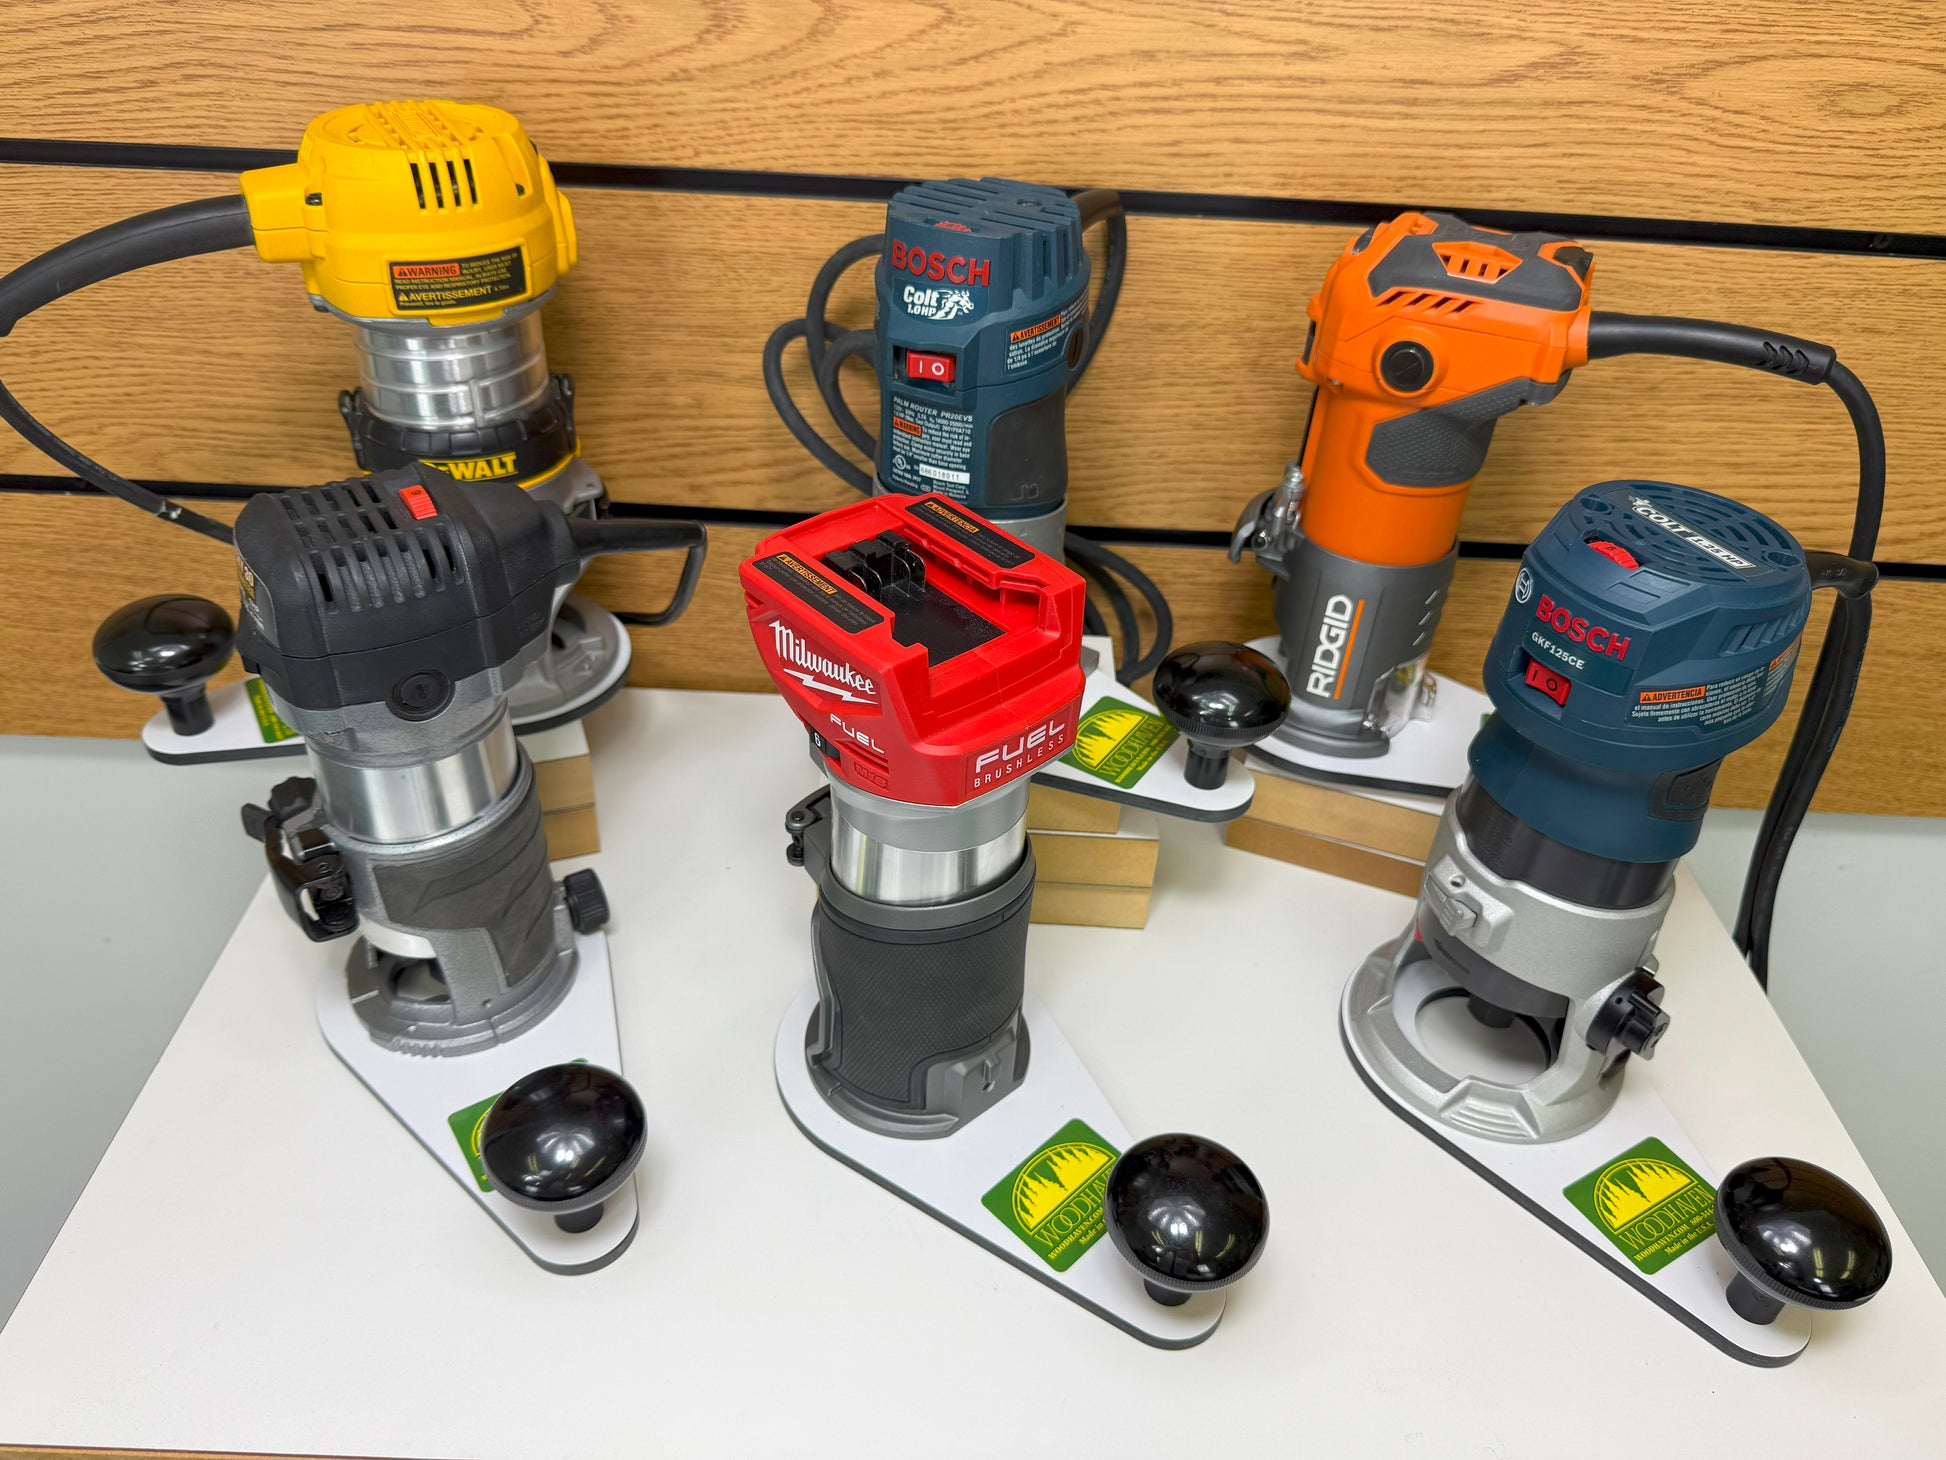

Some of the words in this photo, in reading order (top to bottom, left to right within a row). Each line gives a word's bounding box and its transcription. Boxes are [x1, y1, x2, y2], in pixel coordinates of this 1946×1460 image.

[407, 266, 456, 277] WARNING
[892, 239, 990, 286] BOSCH
[409, 286, 493, 301] AVERTISSEMENT
[903, 284, 939, 306] Colt
[1020, 316, 1060, 338] AVERTISSEMENT
[894, 396, 909, 408] PALM
[910, 403, 937, 416] ROUTER
[941, 411, 973, 422] PR20EVS
[437, 456, 516, 480] WALT
[934, 504, 978, 533] ADVERTENCIA
[1635, 506, 1691, 535] COLT
[1722, 554, 1744, 566] HP
[786, 558, 836, 594] AVERTISSEMENT
[1536, 594, 1631, 661] BOSCH
[769, 619, 876, 695] Milwaukee
[1306, 594, 1352, 699] RIDGID
[1532, 632, 1585, 670] GKF125CE
[1650, 708, 1679, 716] firmemente
[1652, 688, 1702, 701] ADVERTENCIA
[814, 733, 822, 747] 6
[830, 713, 884, 754] FUEL
[975, 720, 1065, 774] FUEL
[974, 734, 1064, 788] BRUSHLESS
[1034, 1166, 1112, 1247] WOODHAV
[1619, 1185, 1714, 1250] WOODHAVEN
[1048, 1207, 1104, 1261] WOODHAVEN.COM
[1079, 1229, 1097, 1245] Made
[1634, 1224, 1690, 1261] WOODHAVEN.COM
[1664, 1246, 1681, 1255] Made
